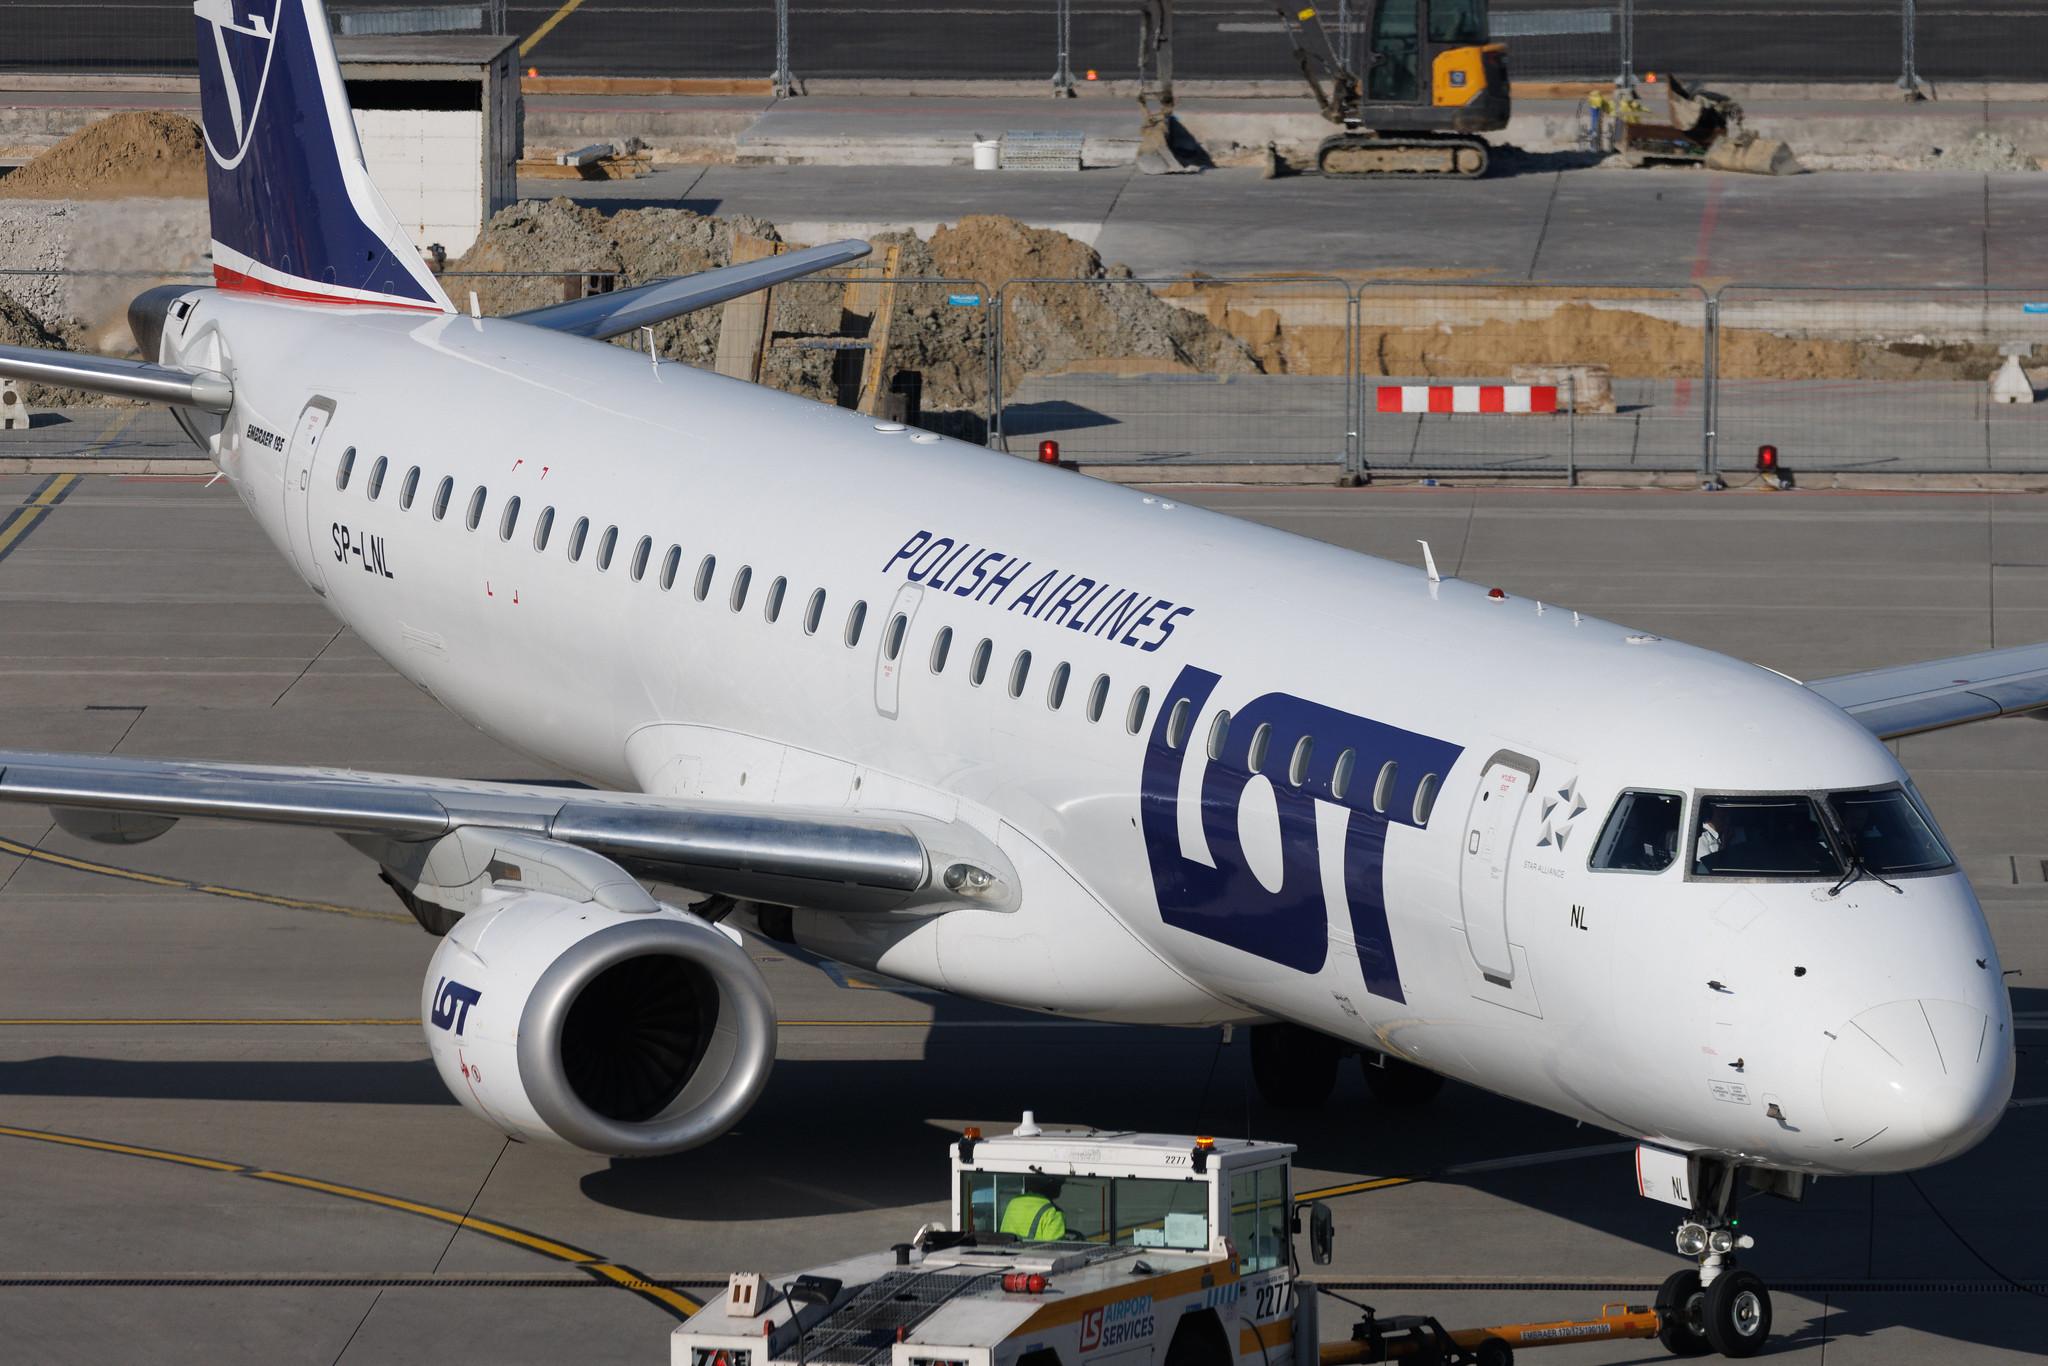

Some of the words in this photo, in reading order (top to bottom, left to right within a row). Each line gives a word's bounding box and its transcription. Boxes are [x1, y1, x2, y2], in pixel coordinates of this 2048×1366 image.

[246, 423, 274, 449] EMBRAER
[273, 434, 286, 453] 195
[332, 522, 394, 579] SP-LNL
[882, 530, 1032, 605] POLISH
[1007, 569, 1195, 652] AIRLINES
[1141, 664, 1465, 1005] LOT
[1523, 860, 1538, 871] STAR
[1537, 865, 1566, 879] ALLIANCE
[1570, 904, 1588, 931] NL
[431, 976, 482, 1036] LOT
[1165, 1155, 1186, 1165] 2277
[1672, 1176, 1687, 1201] NL
[1104, 1295, 1152, 1323] AIRPORT
[1256, 1281, 1293, 1319] 2277
[1102, 1316, 1154, 1347] SERVICES
[1522, 1329, 1557, 1340] EMBRAER
